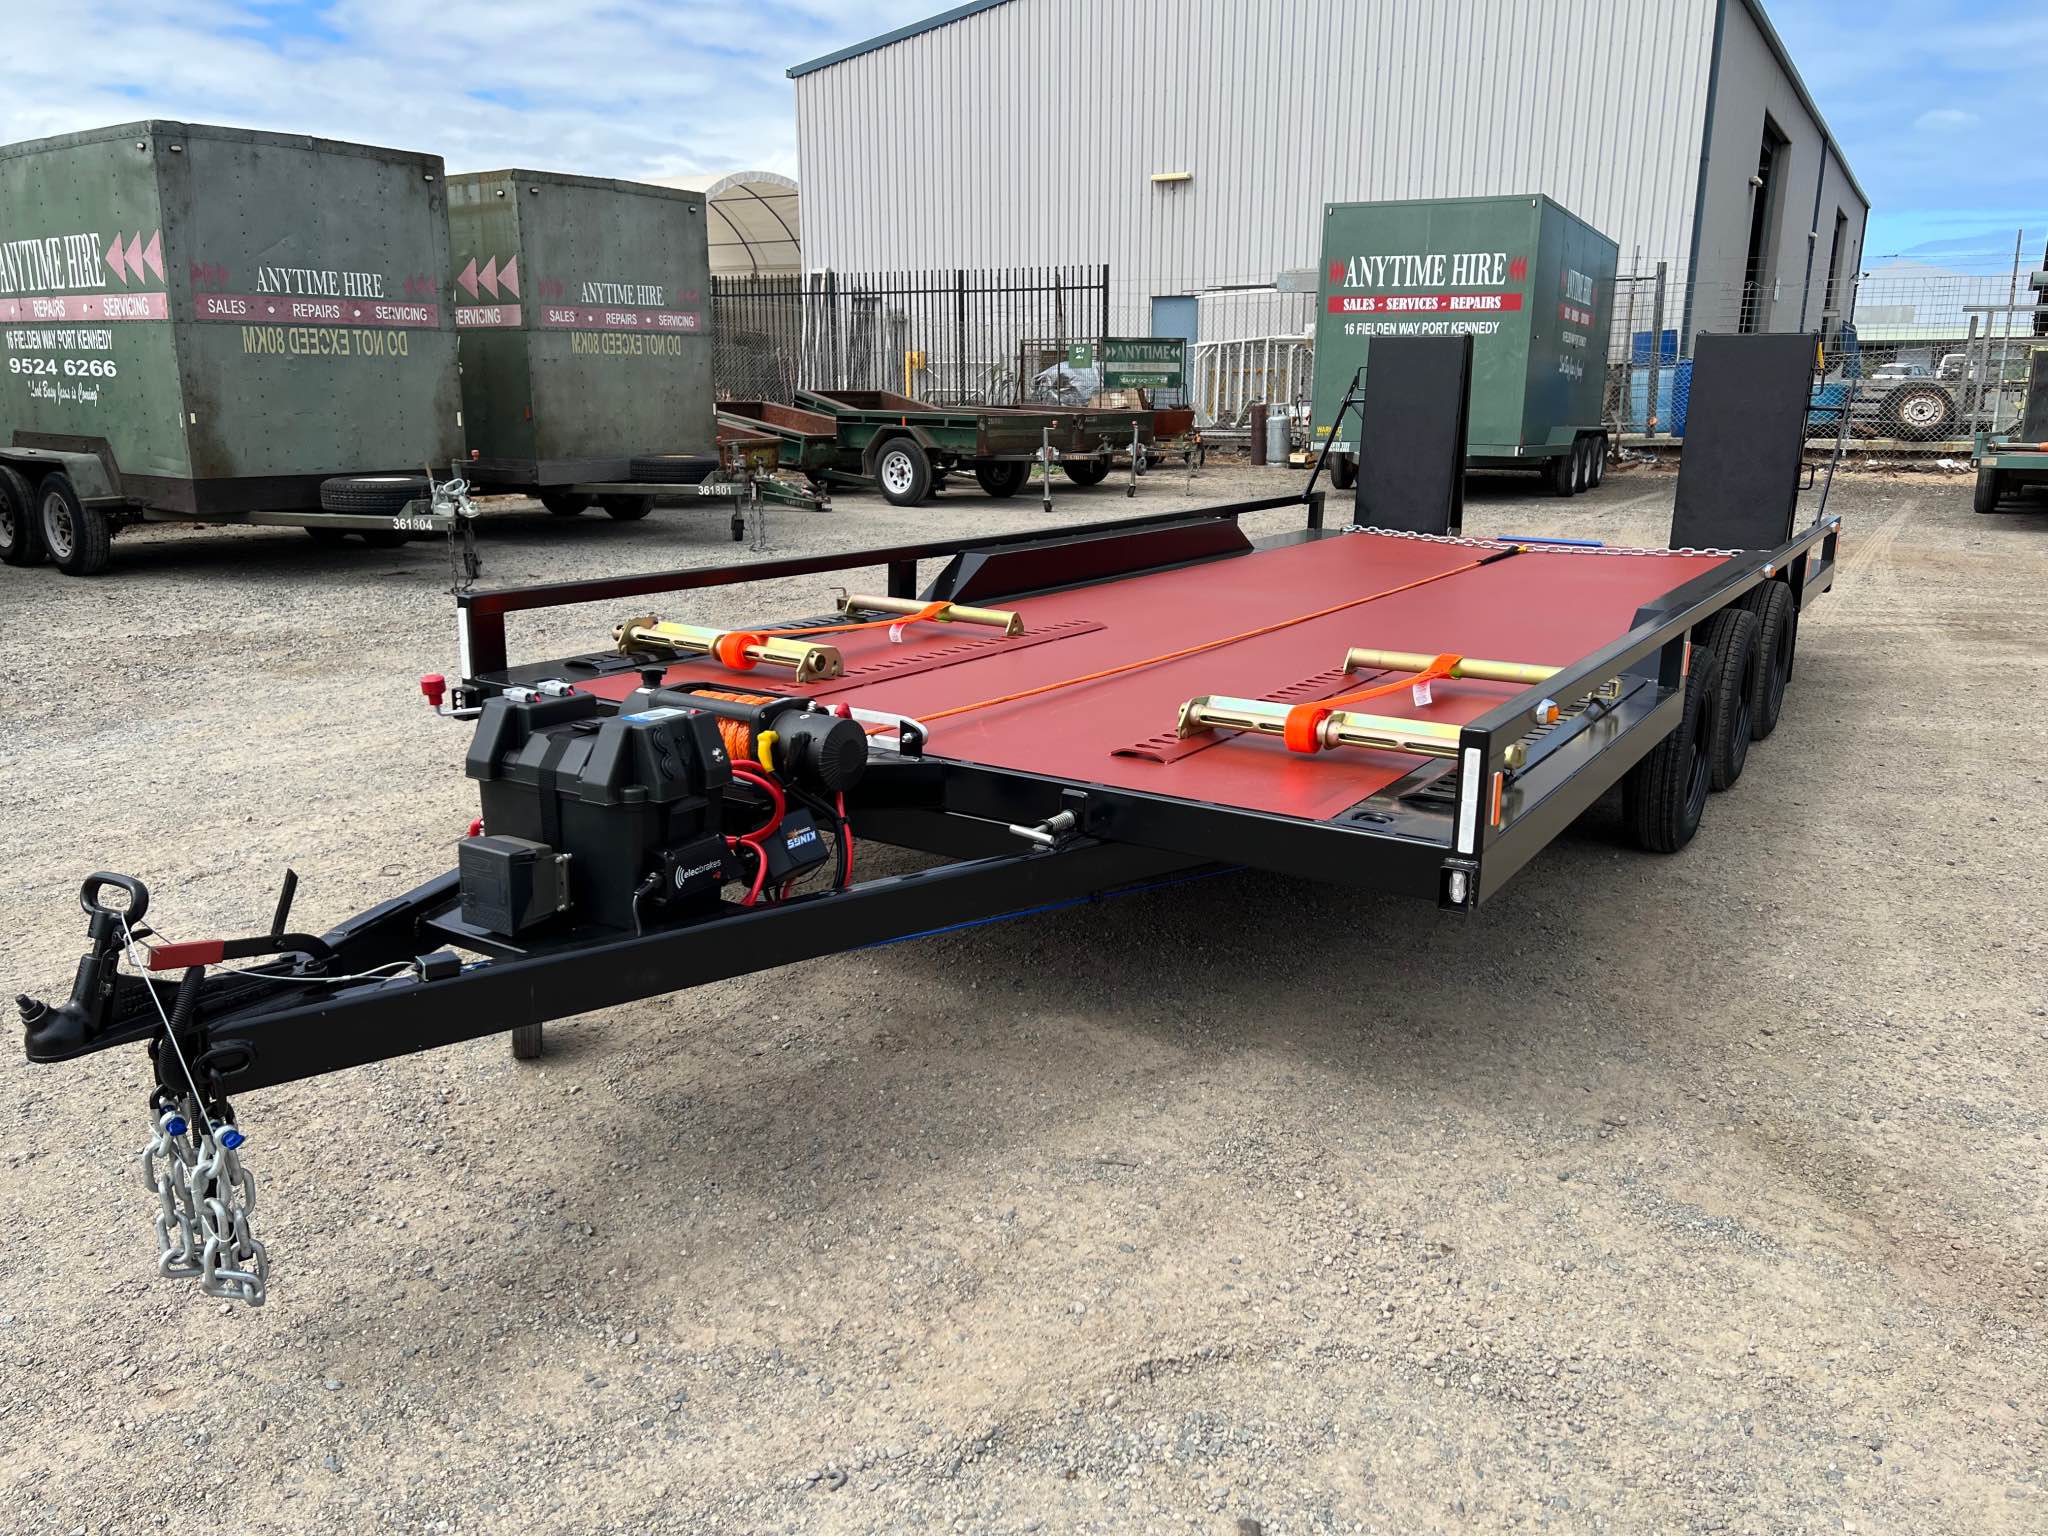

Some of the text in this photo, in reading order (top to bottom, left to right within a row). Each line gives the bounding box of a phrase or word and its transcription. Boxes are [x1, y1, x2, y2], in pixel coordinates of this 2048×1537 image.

[0, 232, 106, 293] ANYTIME HIRE
[1344, 252, 1506, 288] ANYTIME HIRE
[256, 266, 384, 298] ANYTIME HIRE
[581, 282, 664, 306] ANYTIME HIRE
[1344, 298, 1375, 311] SALES
[1386, 296, 1438, 310] SERVICES
[1450, 296, 1501, 310] REPAIRS
[33, 297, 150, 318] REPAIRS SERVICING
[208, 298, 428, 321] SALES REPAIRS SERVICING
[549, 310, 694, 327] SALES REPAIRS SERVICING
[1344, 322, 1500, 335] 16 FIELDEN WAY PORT KENNEDY
[14, 330, 42, 349] FIELDEN
[41, 330, 56, 349] WAY
[57, 330, 76, 350] PORT
[76, 330, 112, 350] KENNEDY
[1116, 345, 1170, 360] ANYTIME
[9, 358, 117, 378] 9524 6266
[698, 486, 732, 496] 361801
[392, 518, 432, 530] 361804
[786, 830, 816, 850] KINGS
[684, 860, 721, 878] elecbrakes
